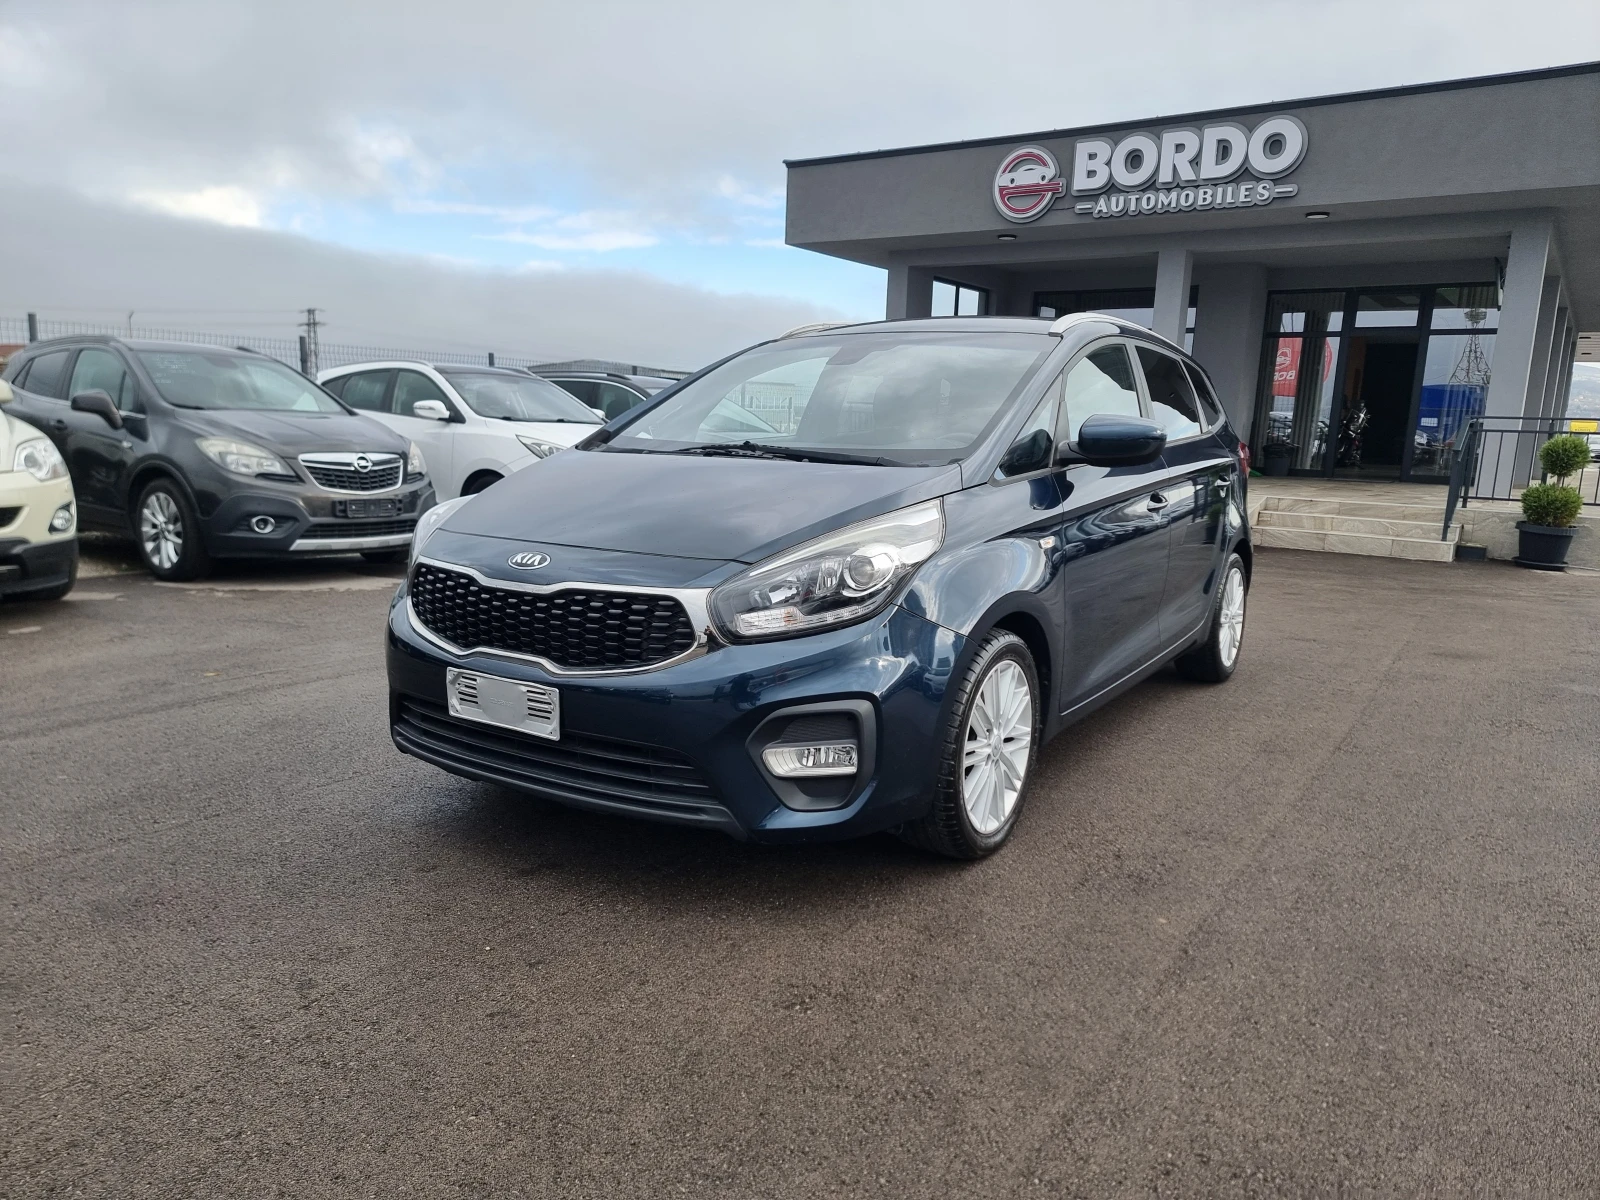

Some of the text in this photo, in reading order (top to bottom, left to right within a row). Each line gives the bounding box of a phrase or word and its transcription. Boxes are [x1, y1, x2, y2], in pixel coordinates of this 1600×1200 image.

[1073, 118, 1303, 191] BORDO
[1095, 183, 1271, 214] AUTOMOBILES
[512, 552, 542, 566] KIA
